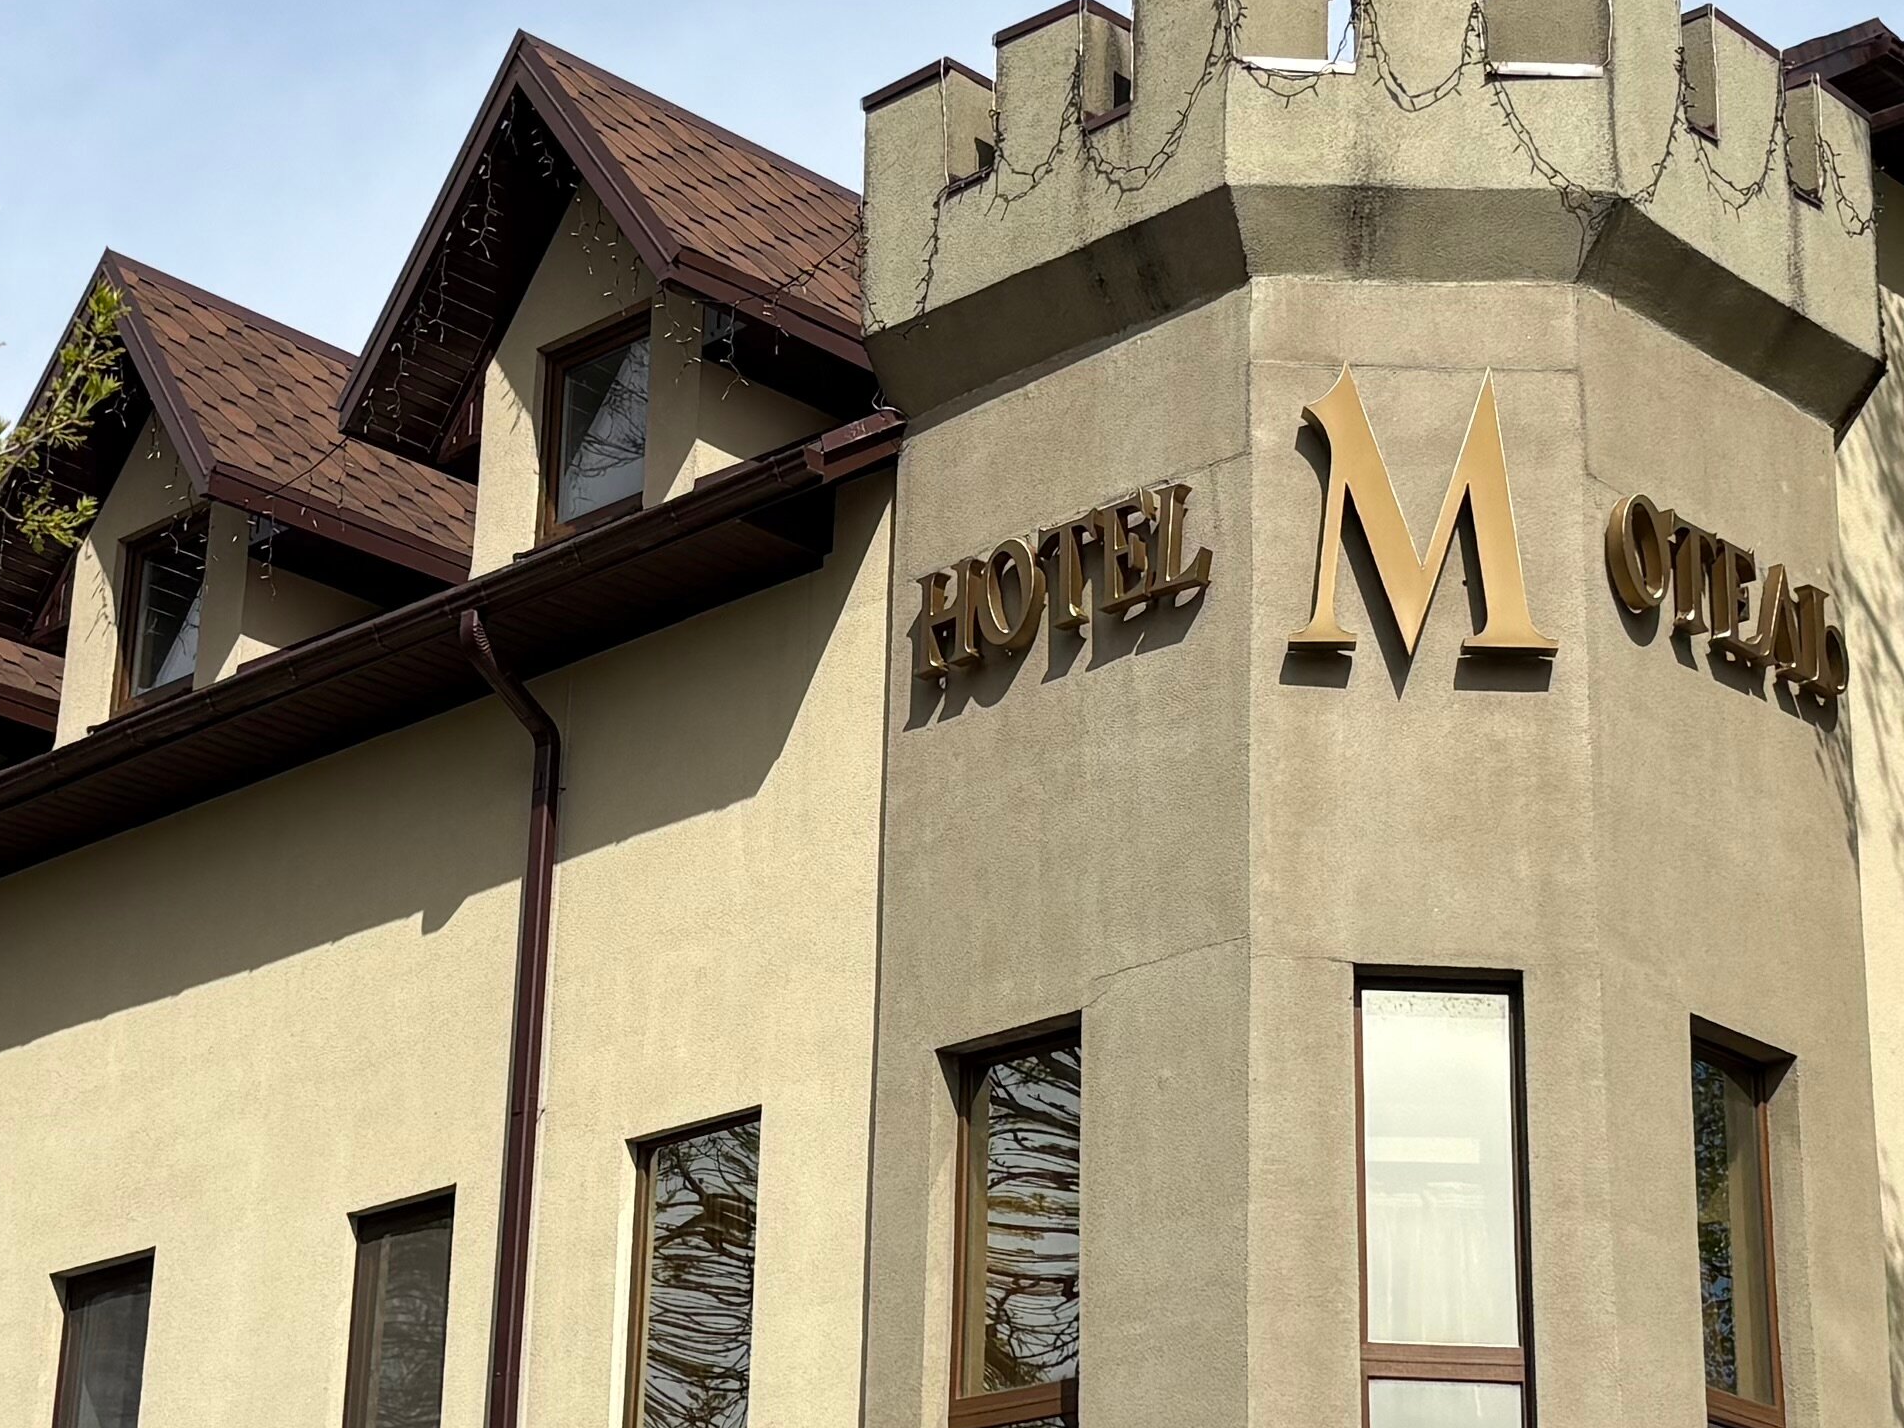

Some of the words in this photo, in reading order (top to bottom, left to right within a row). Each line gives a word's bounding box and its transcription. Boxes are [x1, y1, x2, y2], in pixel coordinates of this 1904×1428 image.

[914, 482, 1214, 680] HOTEL
[1287, 360, 1559, 657] M
[1604, 492, 1850, 698] ОТЕЛЬ
